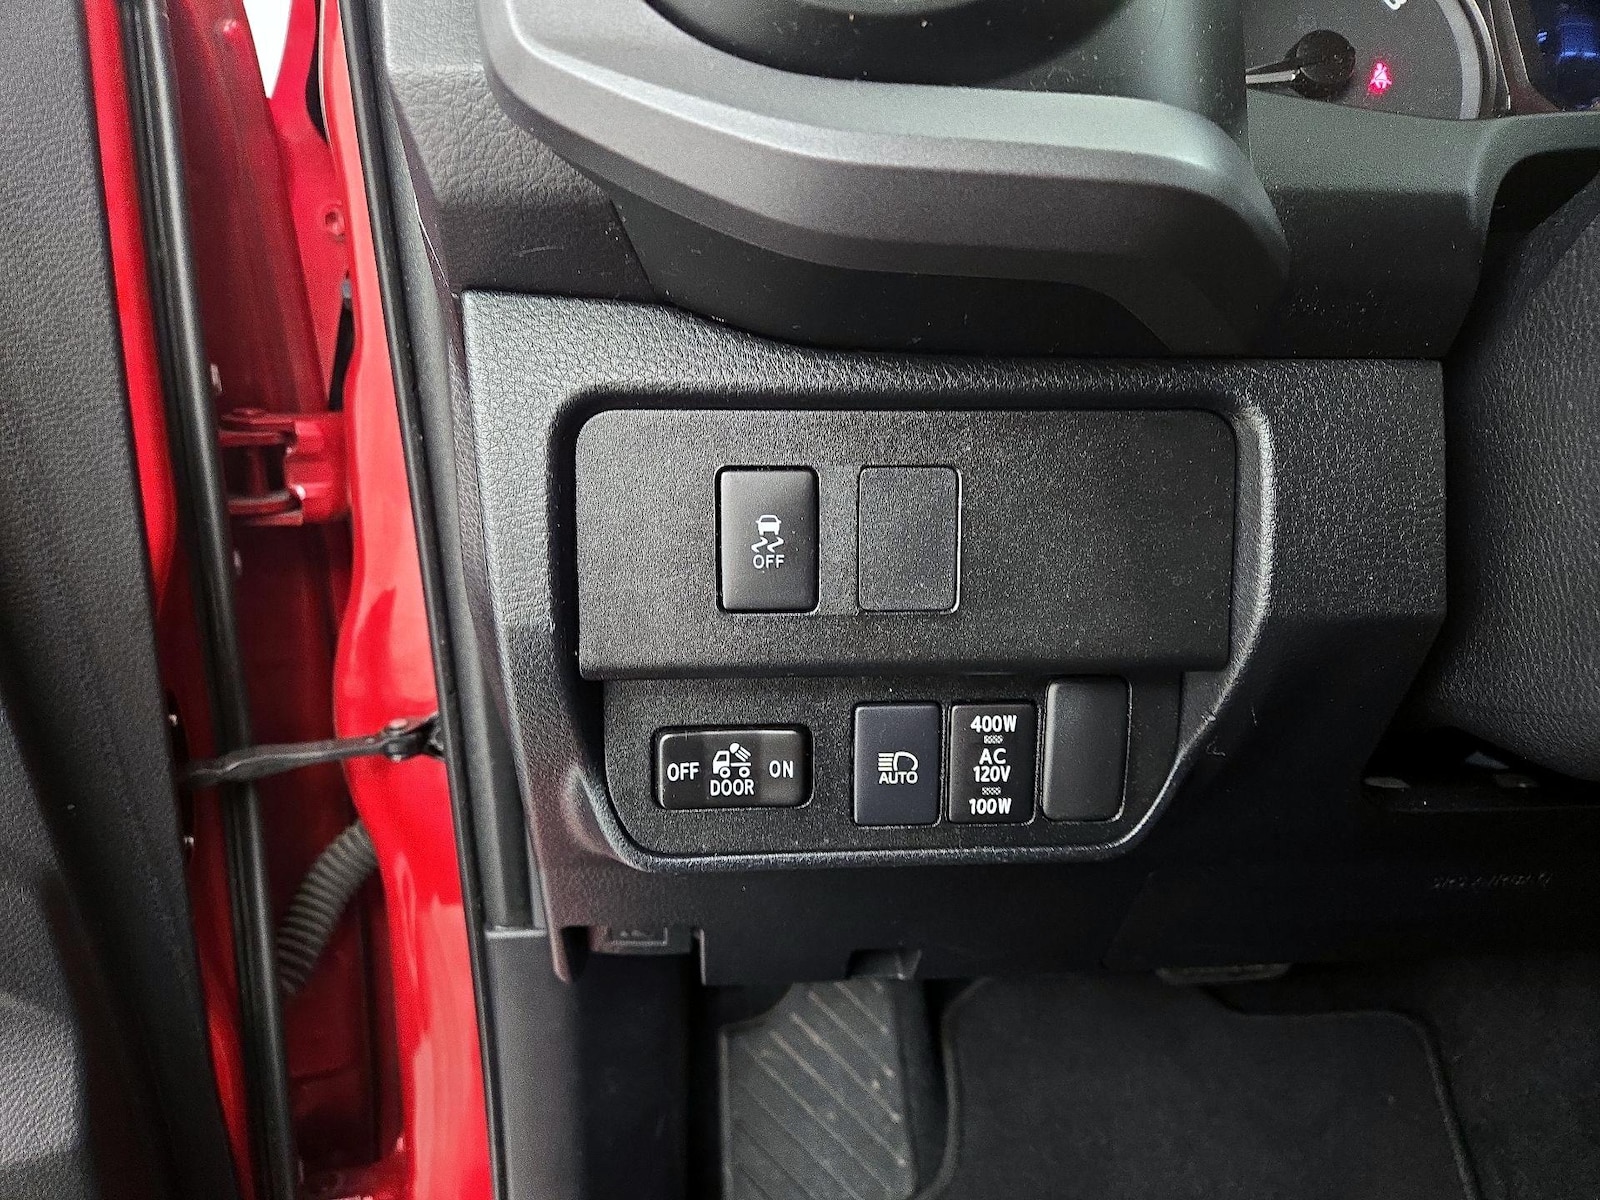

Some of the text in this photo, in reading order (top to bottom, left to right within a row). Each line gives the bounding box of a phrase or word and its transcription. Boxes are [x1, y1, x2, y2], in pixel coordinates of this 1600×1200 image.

[752, 554, 785, 569] OFF
[970, 715, 1017, 732] 400W
[979, 748, 1007, 765] AC
[667, 762, 700, 781] OFF
[769, 760, 794, 778] ON
[878, 771, 918, 784] AUTO
[973, 765, 1011, 782] 120V
[710, 779, 754, 796] DOOR
[968, 798, 1012, 815] 100W
